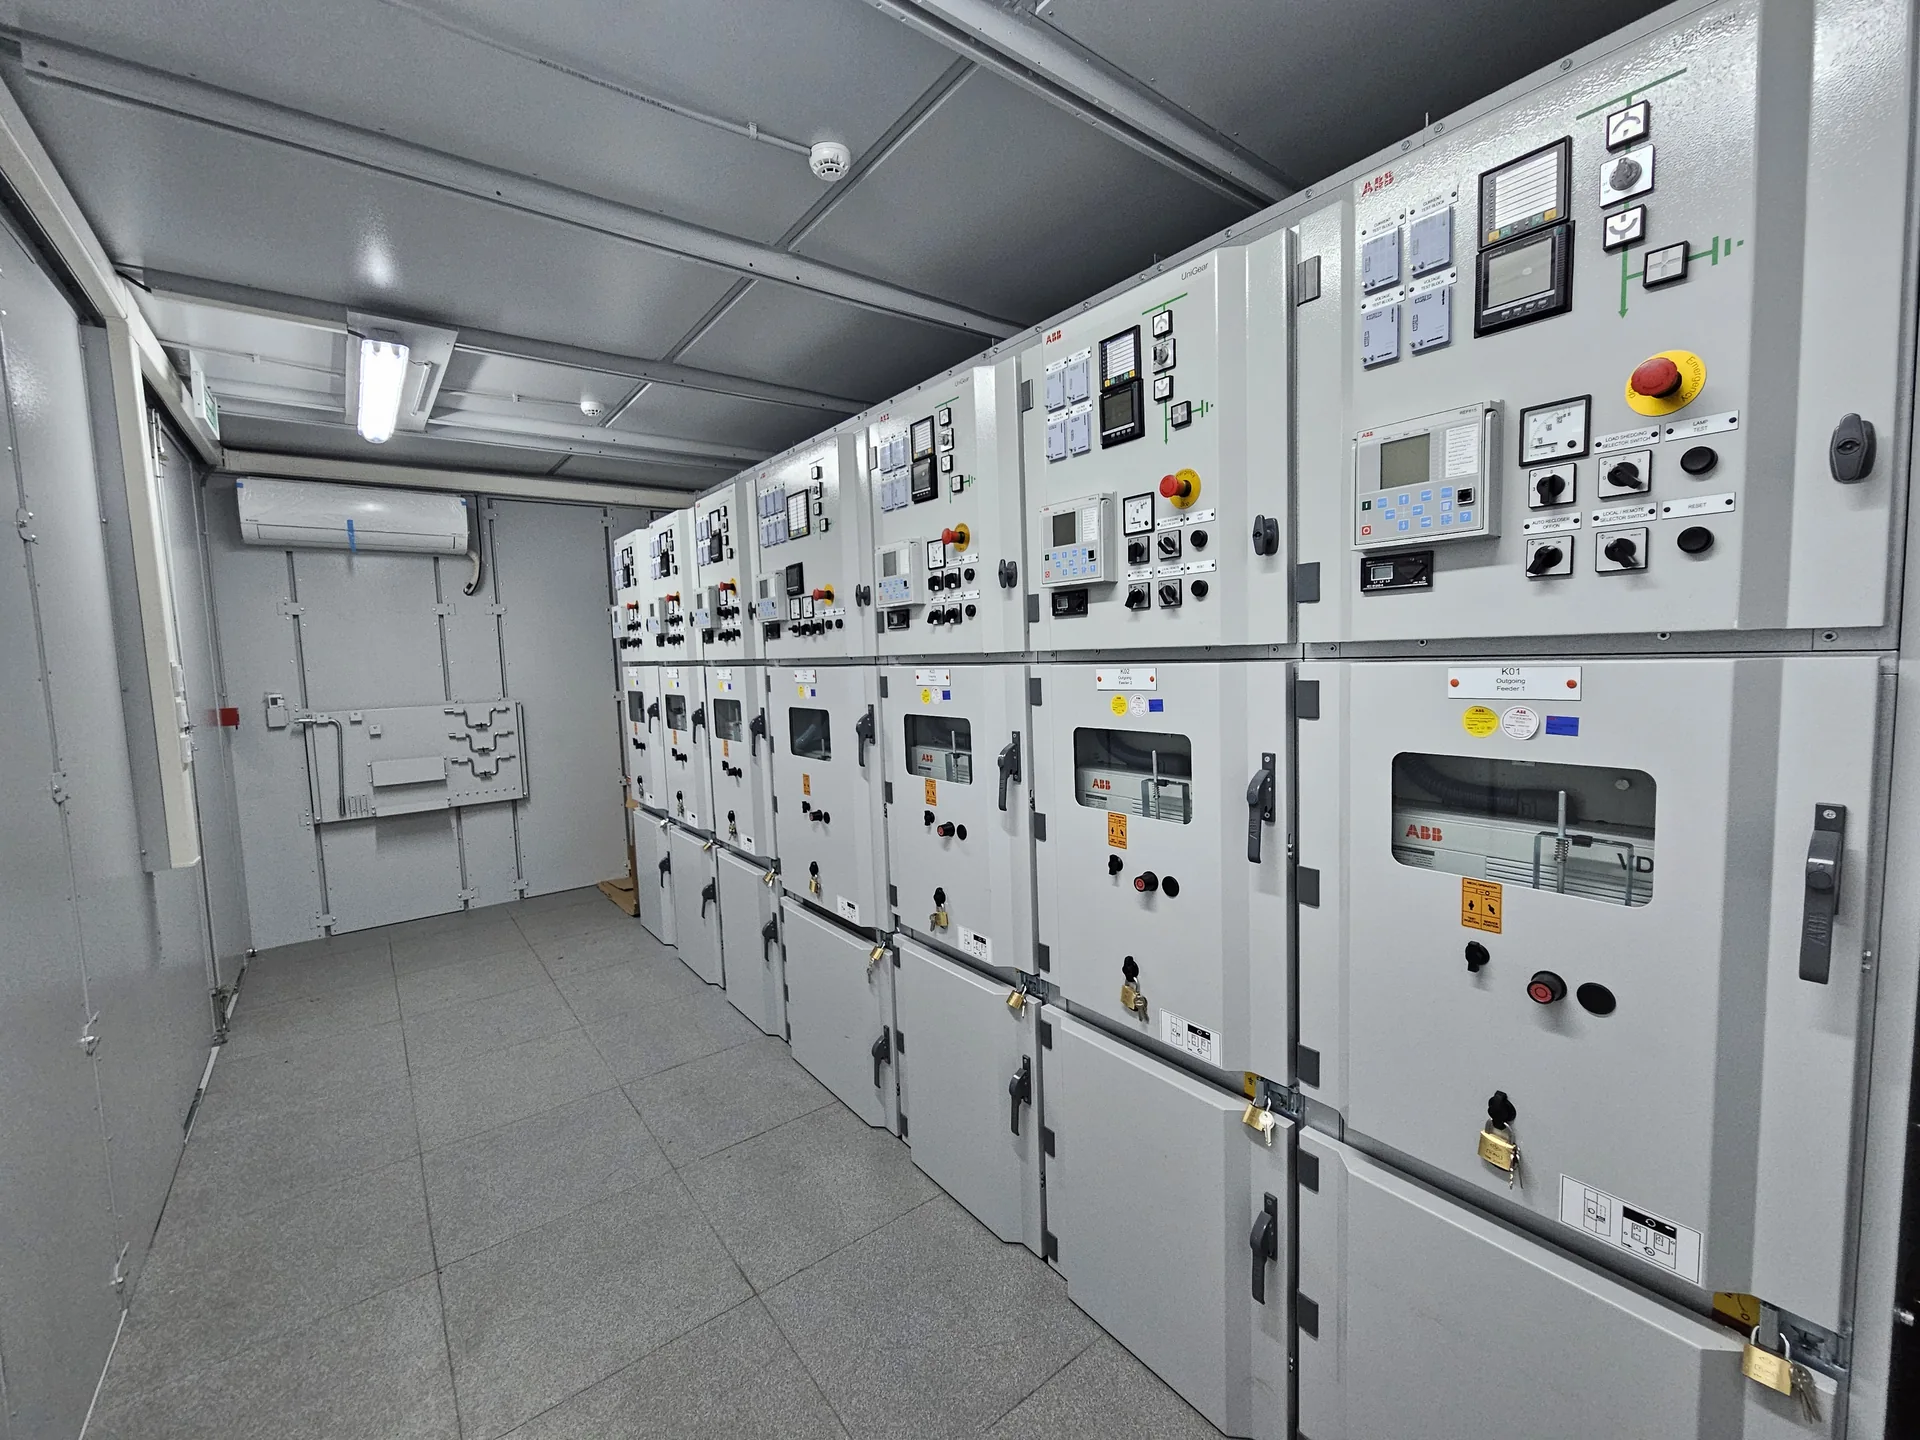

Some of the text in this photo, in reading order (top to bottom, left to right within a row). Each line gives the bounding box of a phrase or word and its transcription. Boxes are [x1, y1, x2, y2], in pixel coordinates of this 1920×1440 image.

[1362, 171, 1394, 197] ABB
[1182, 262, 1208, 280] UniGear
[1046, 330, 1062, 345] ABB
[1681, 356, 1701, 402] Emergency
[1620, 430, 1648, 439] SHEDDING
[1602, 436, 1651, 449] SELECTOR SWITCH
[1502, 668, 1520, 676] K01
[922, 754, 934, 763] ABB
[1092, 778, 1111, 790] ABB
[1406, 824, 1442, 842] ABB
